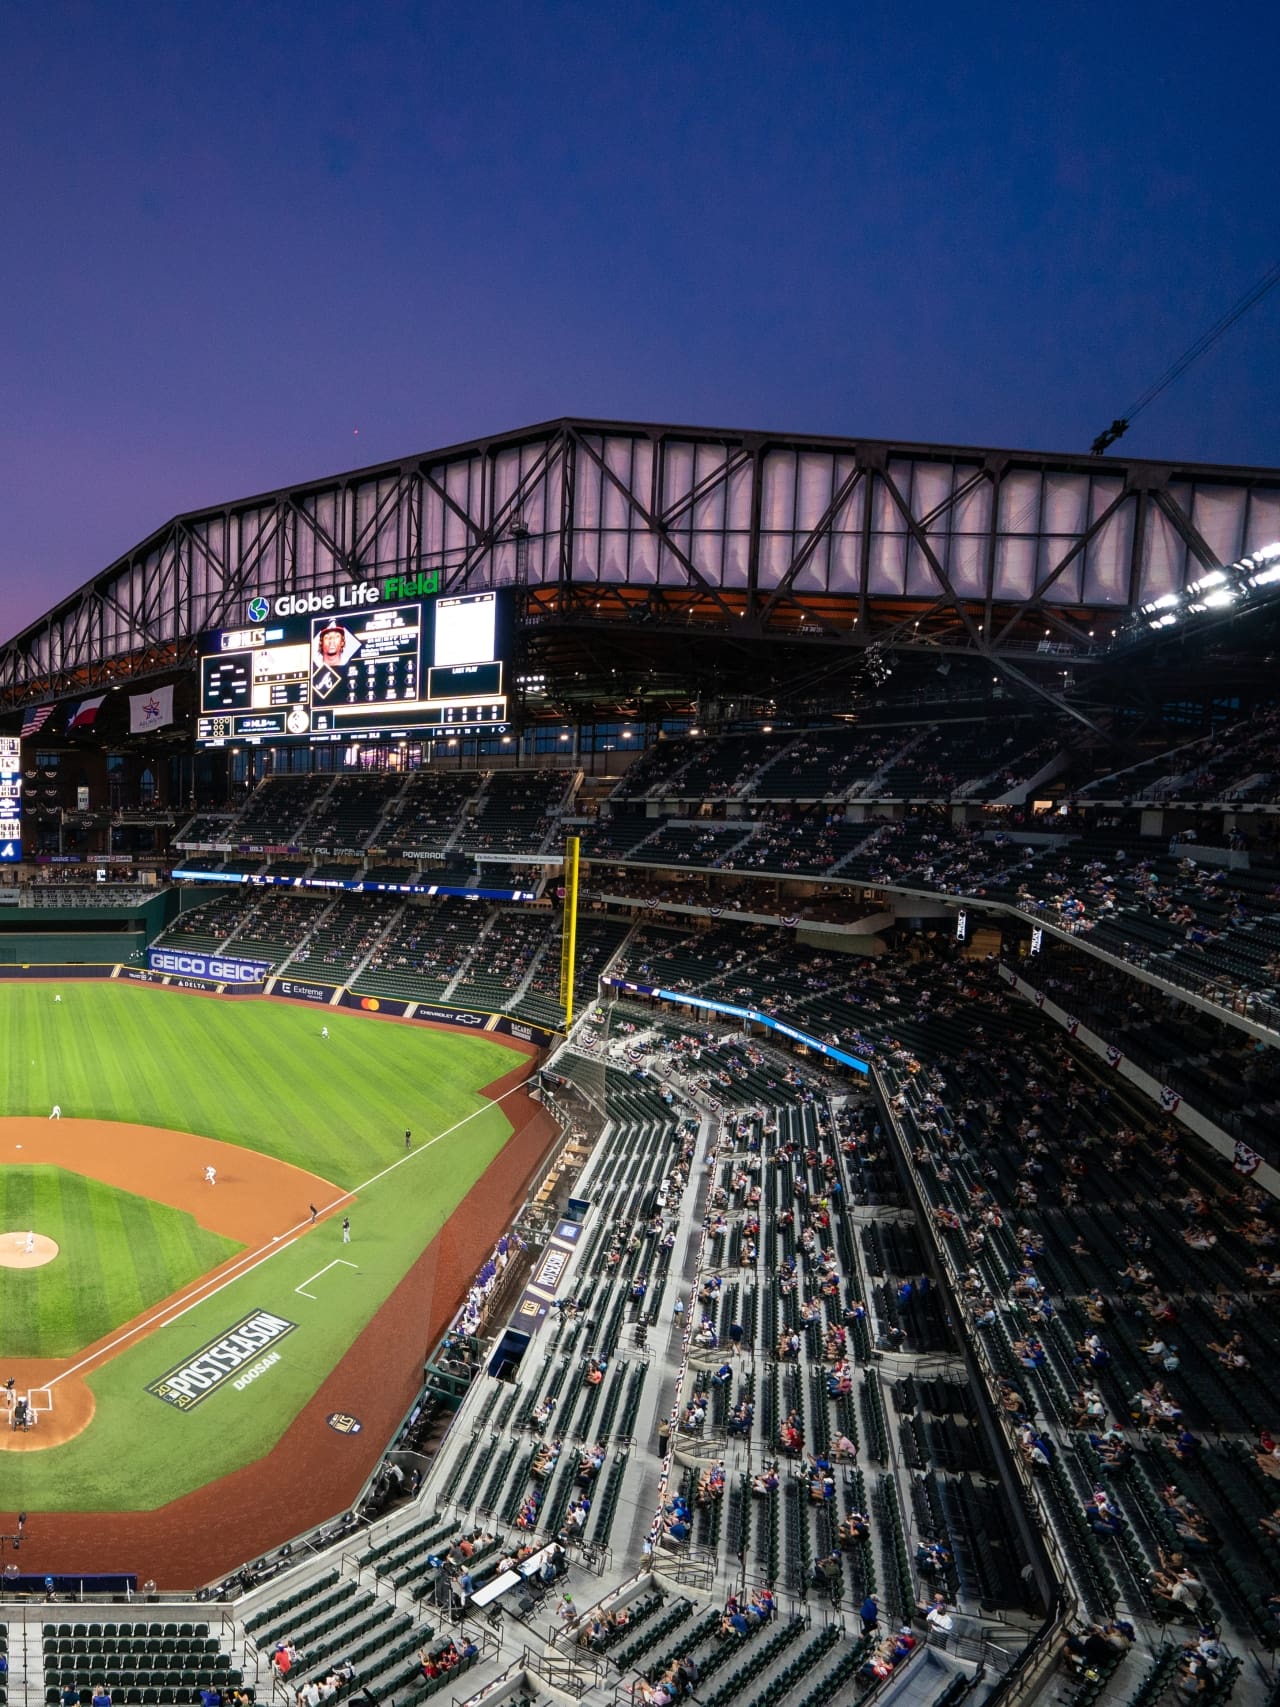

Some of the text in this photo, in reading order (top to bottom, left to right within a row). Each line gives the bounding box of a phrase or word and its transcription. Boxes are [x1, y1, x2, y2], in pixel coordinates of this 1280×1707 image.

[275, 570, 439, 616] Globe Life Field
[402, 851, 445, 860] POWERADE
[151, 953, 206, 975] GEICO
[294, 986, 323, 997] Extreme
[420, 1010, 454, 1019] CHEVROLET
[166, 1312, 291, 1398] POSTSEASON
[232, 1351, 282, 1391] DOOSAN
[154, 1385, 171, 1396] 20
[174, 1395, 191, 1407] 20
